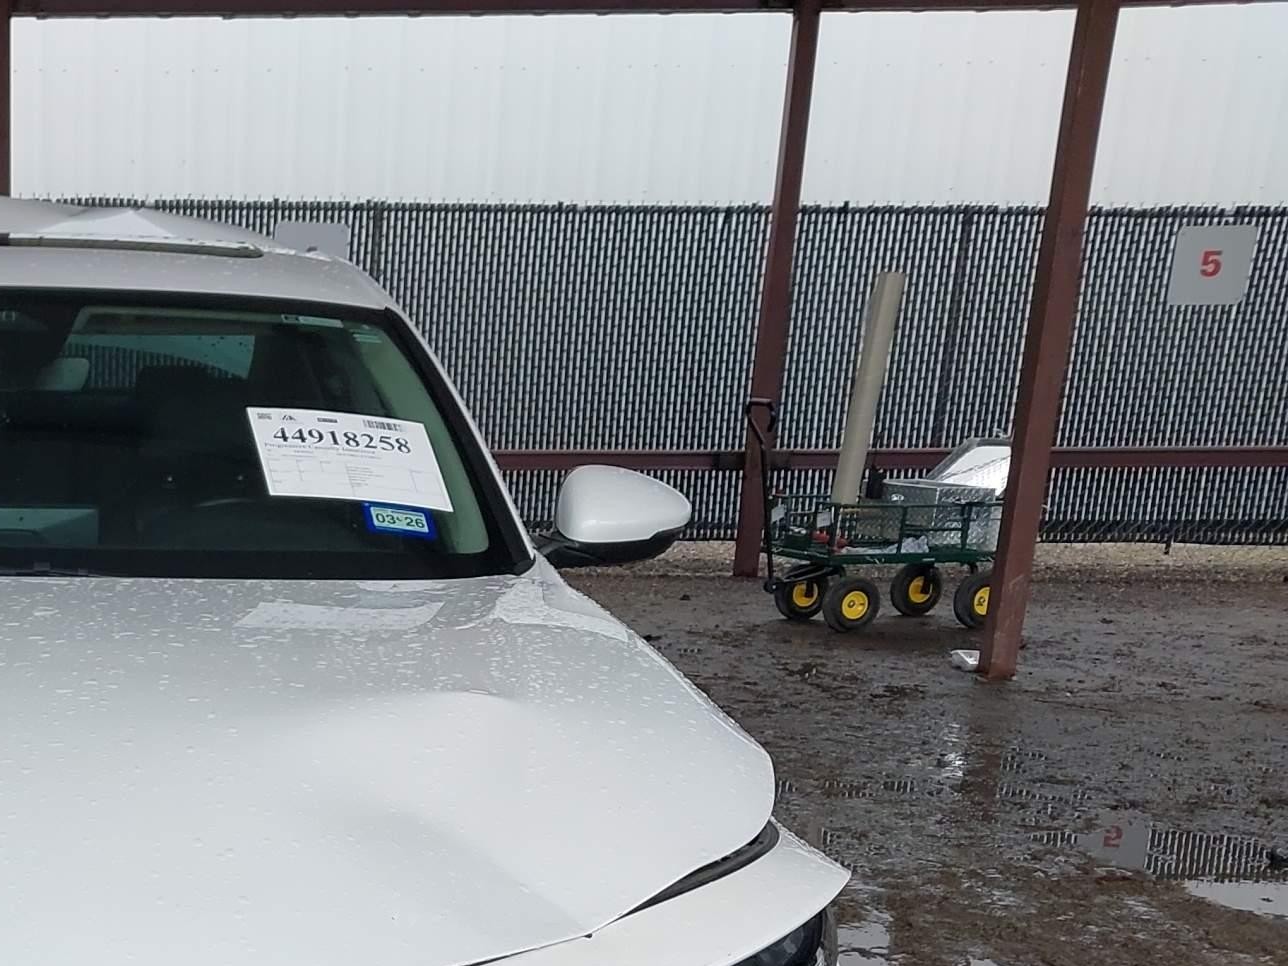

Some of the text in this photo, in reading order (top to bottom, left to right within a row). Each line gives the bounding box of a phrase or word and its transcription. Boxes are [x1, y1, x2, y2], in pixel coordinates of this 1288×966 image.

[1199, 250, 1223, 278] 5
[273, 427, 411, 455] 44918258
[375, 513, 425, 529] 03 26
